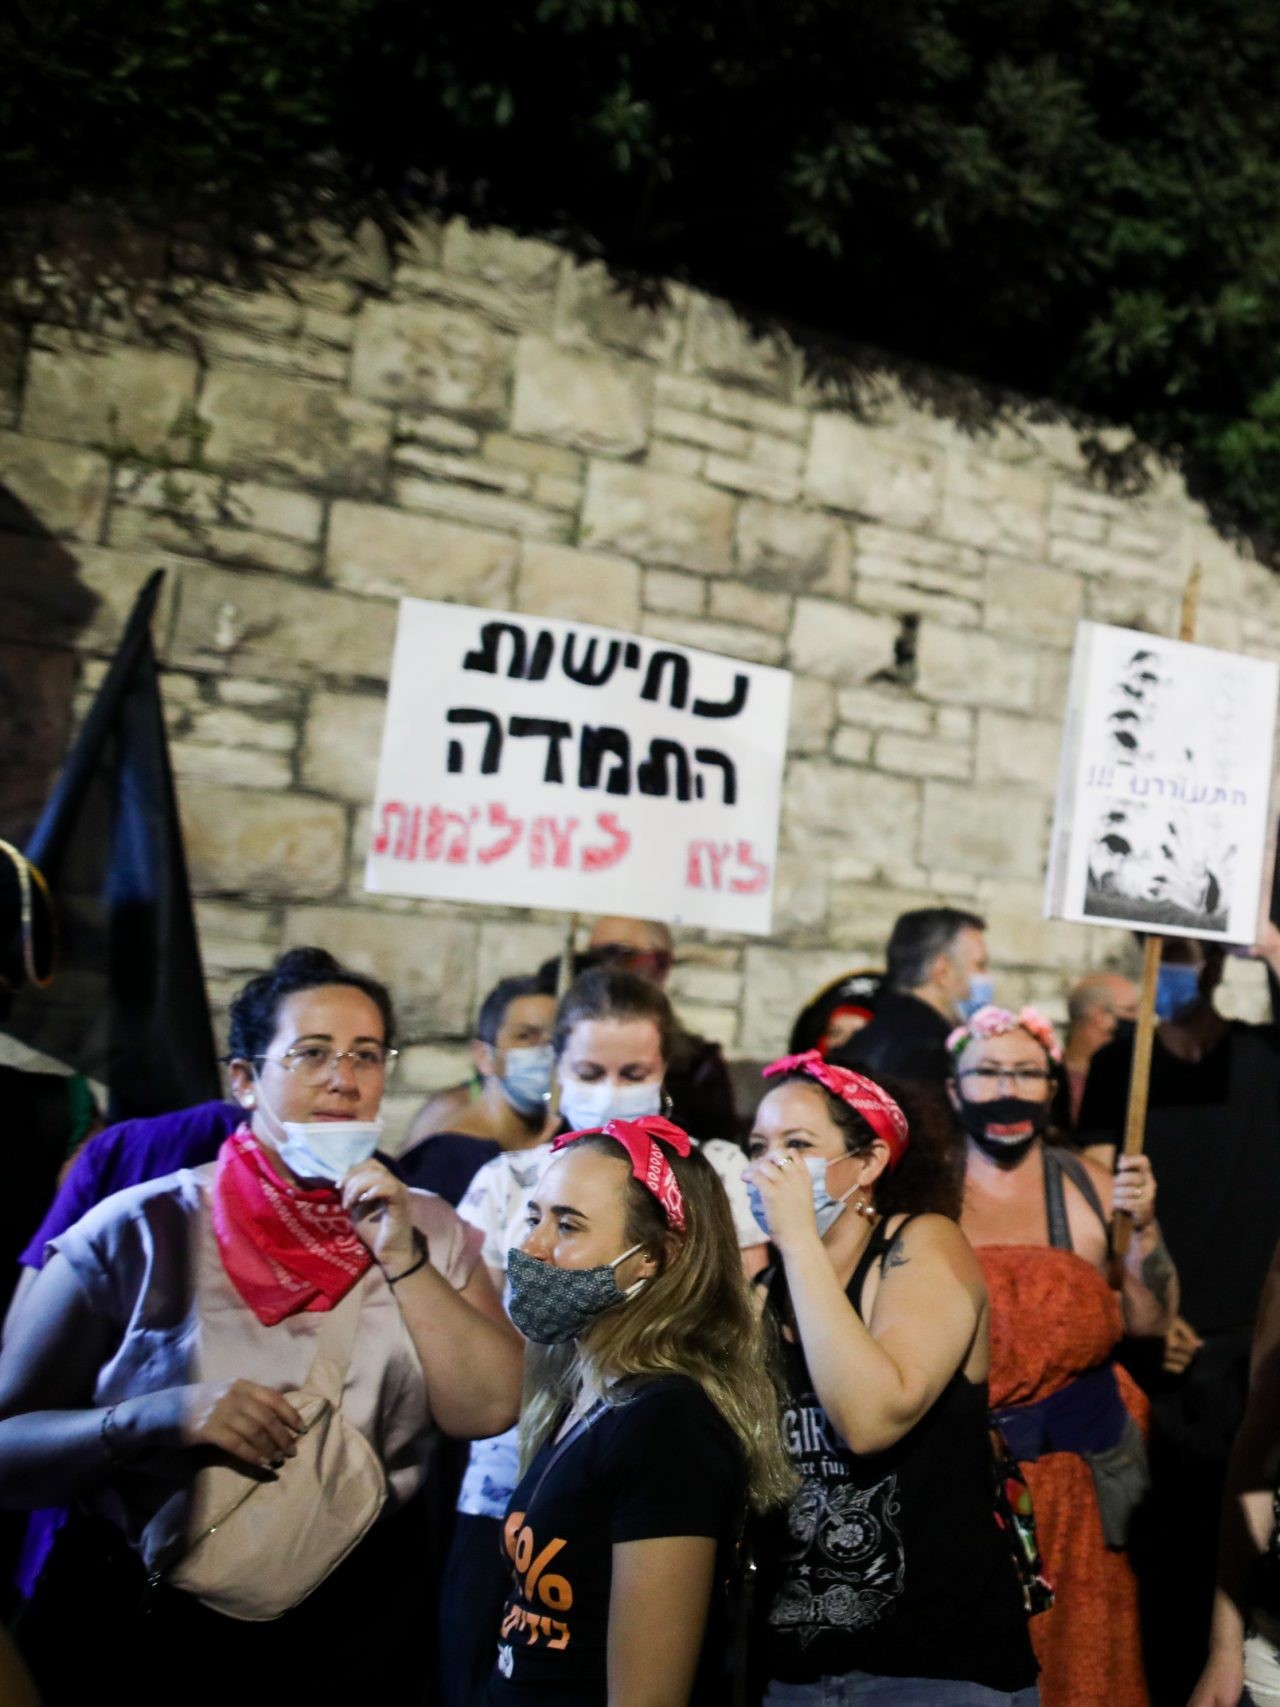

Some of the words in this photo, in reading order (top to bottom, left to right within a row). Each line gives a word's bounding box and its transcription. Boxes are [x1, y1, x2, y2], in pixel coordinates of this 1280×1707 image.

[463, 622, 750, 719] נחישות
[446, 708, 737, 805] התמדה
[373, 801, 632, 873] לאלימות
[686, 838, 768, 894] לא
